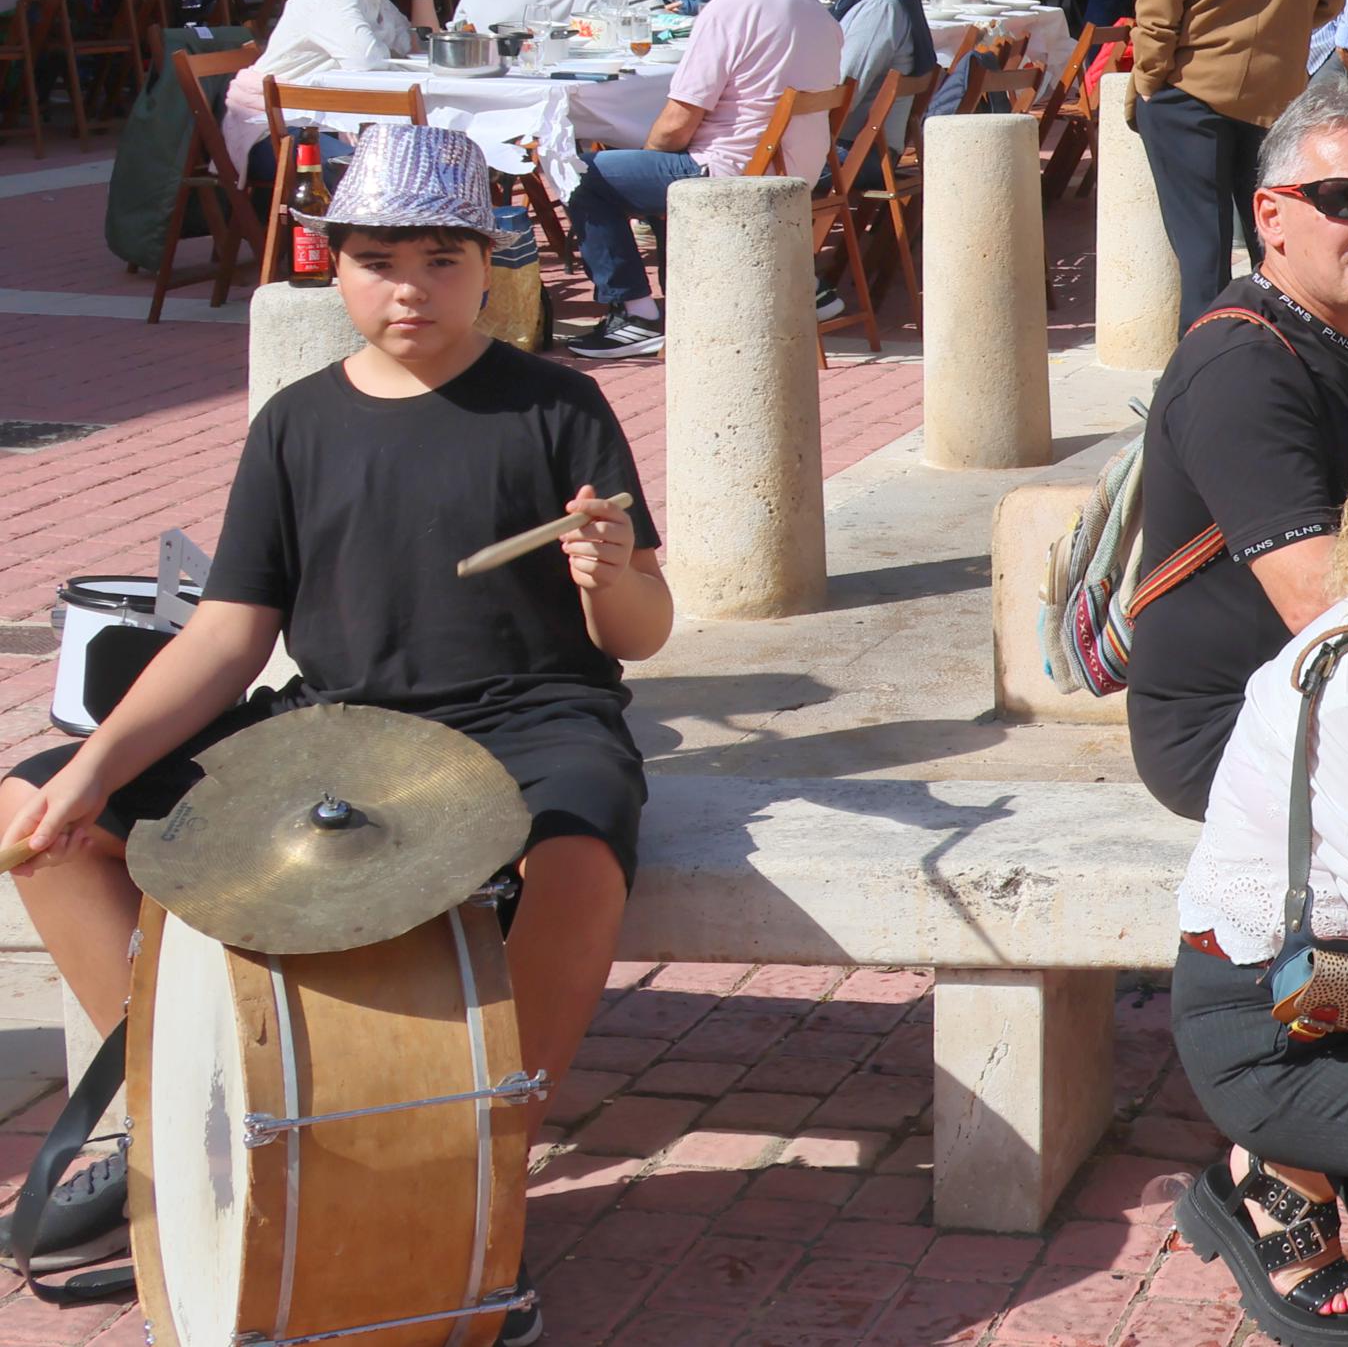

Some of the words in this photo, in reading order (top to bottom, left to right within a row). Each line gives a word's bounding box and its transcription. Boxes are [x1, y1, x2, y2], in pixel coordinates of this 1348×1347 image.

[1279, 294, 1313, 322] PLNS
[1244, 539, 1274, 557] PLNS
[1285, 524, 1323, 540] PLNS
